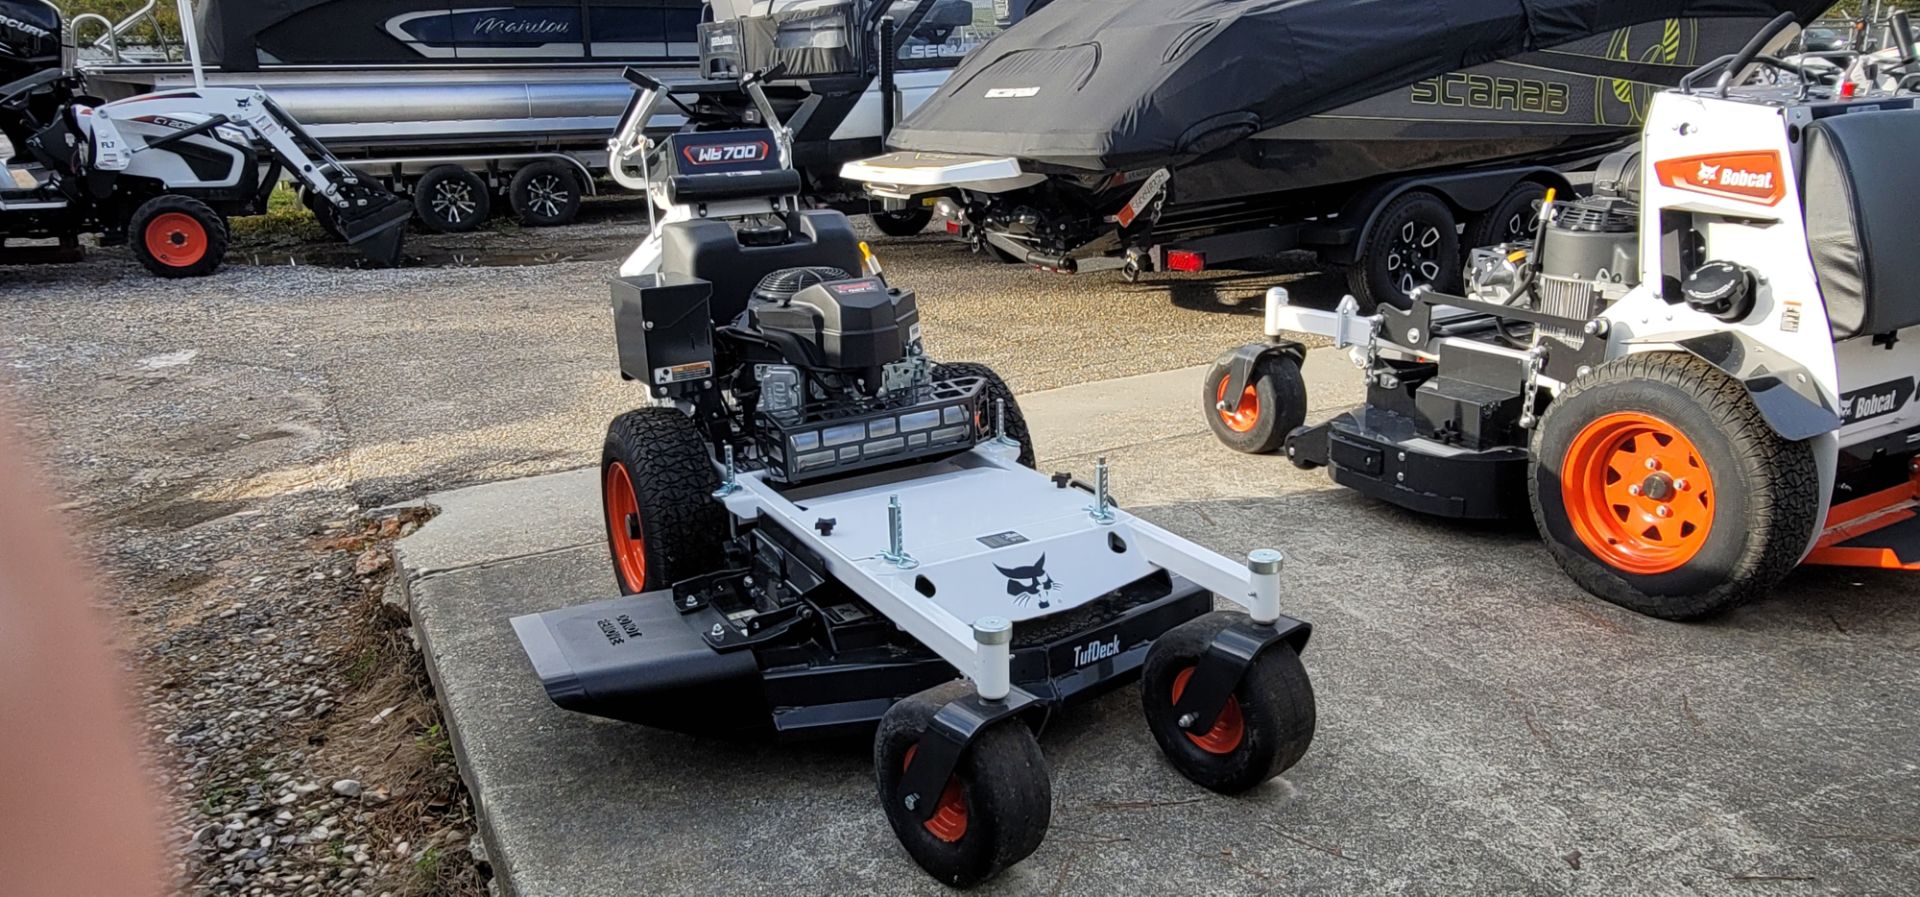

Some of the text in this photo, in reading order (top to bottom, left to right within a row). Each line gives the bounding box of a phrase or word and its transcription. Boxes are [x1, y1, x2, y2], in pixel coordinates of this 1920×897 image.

[1720, 168, 1772, 189] Bobcat
[1855, 389, 1896, 419] Bobcat
[1073, 634, 1120, 668] TufDeck
